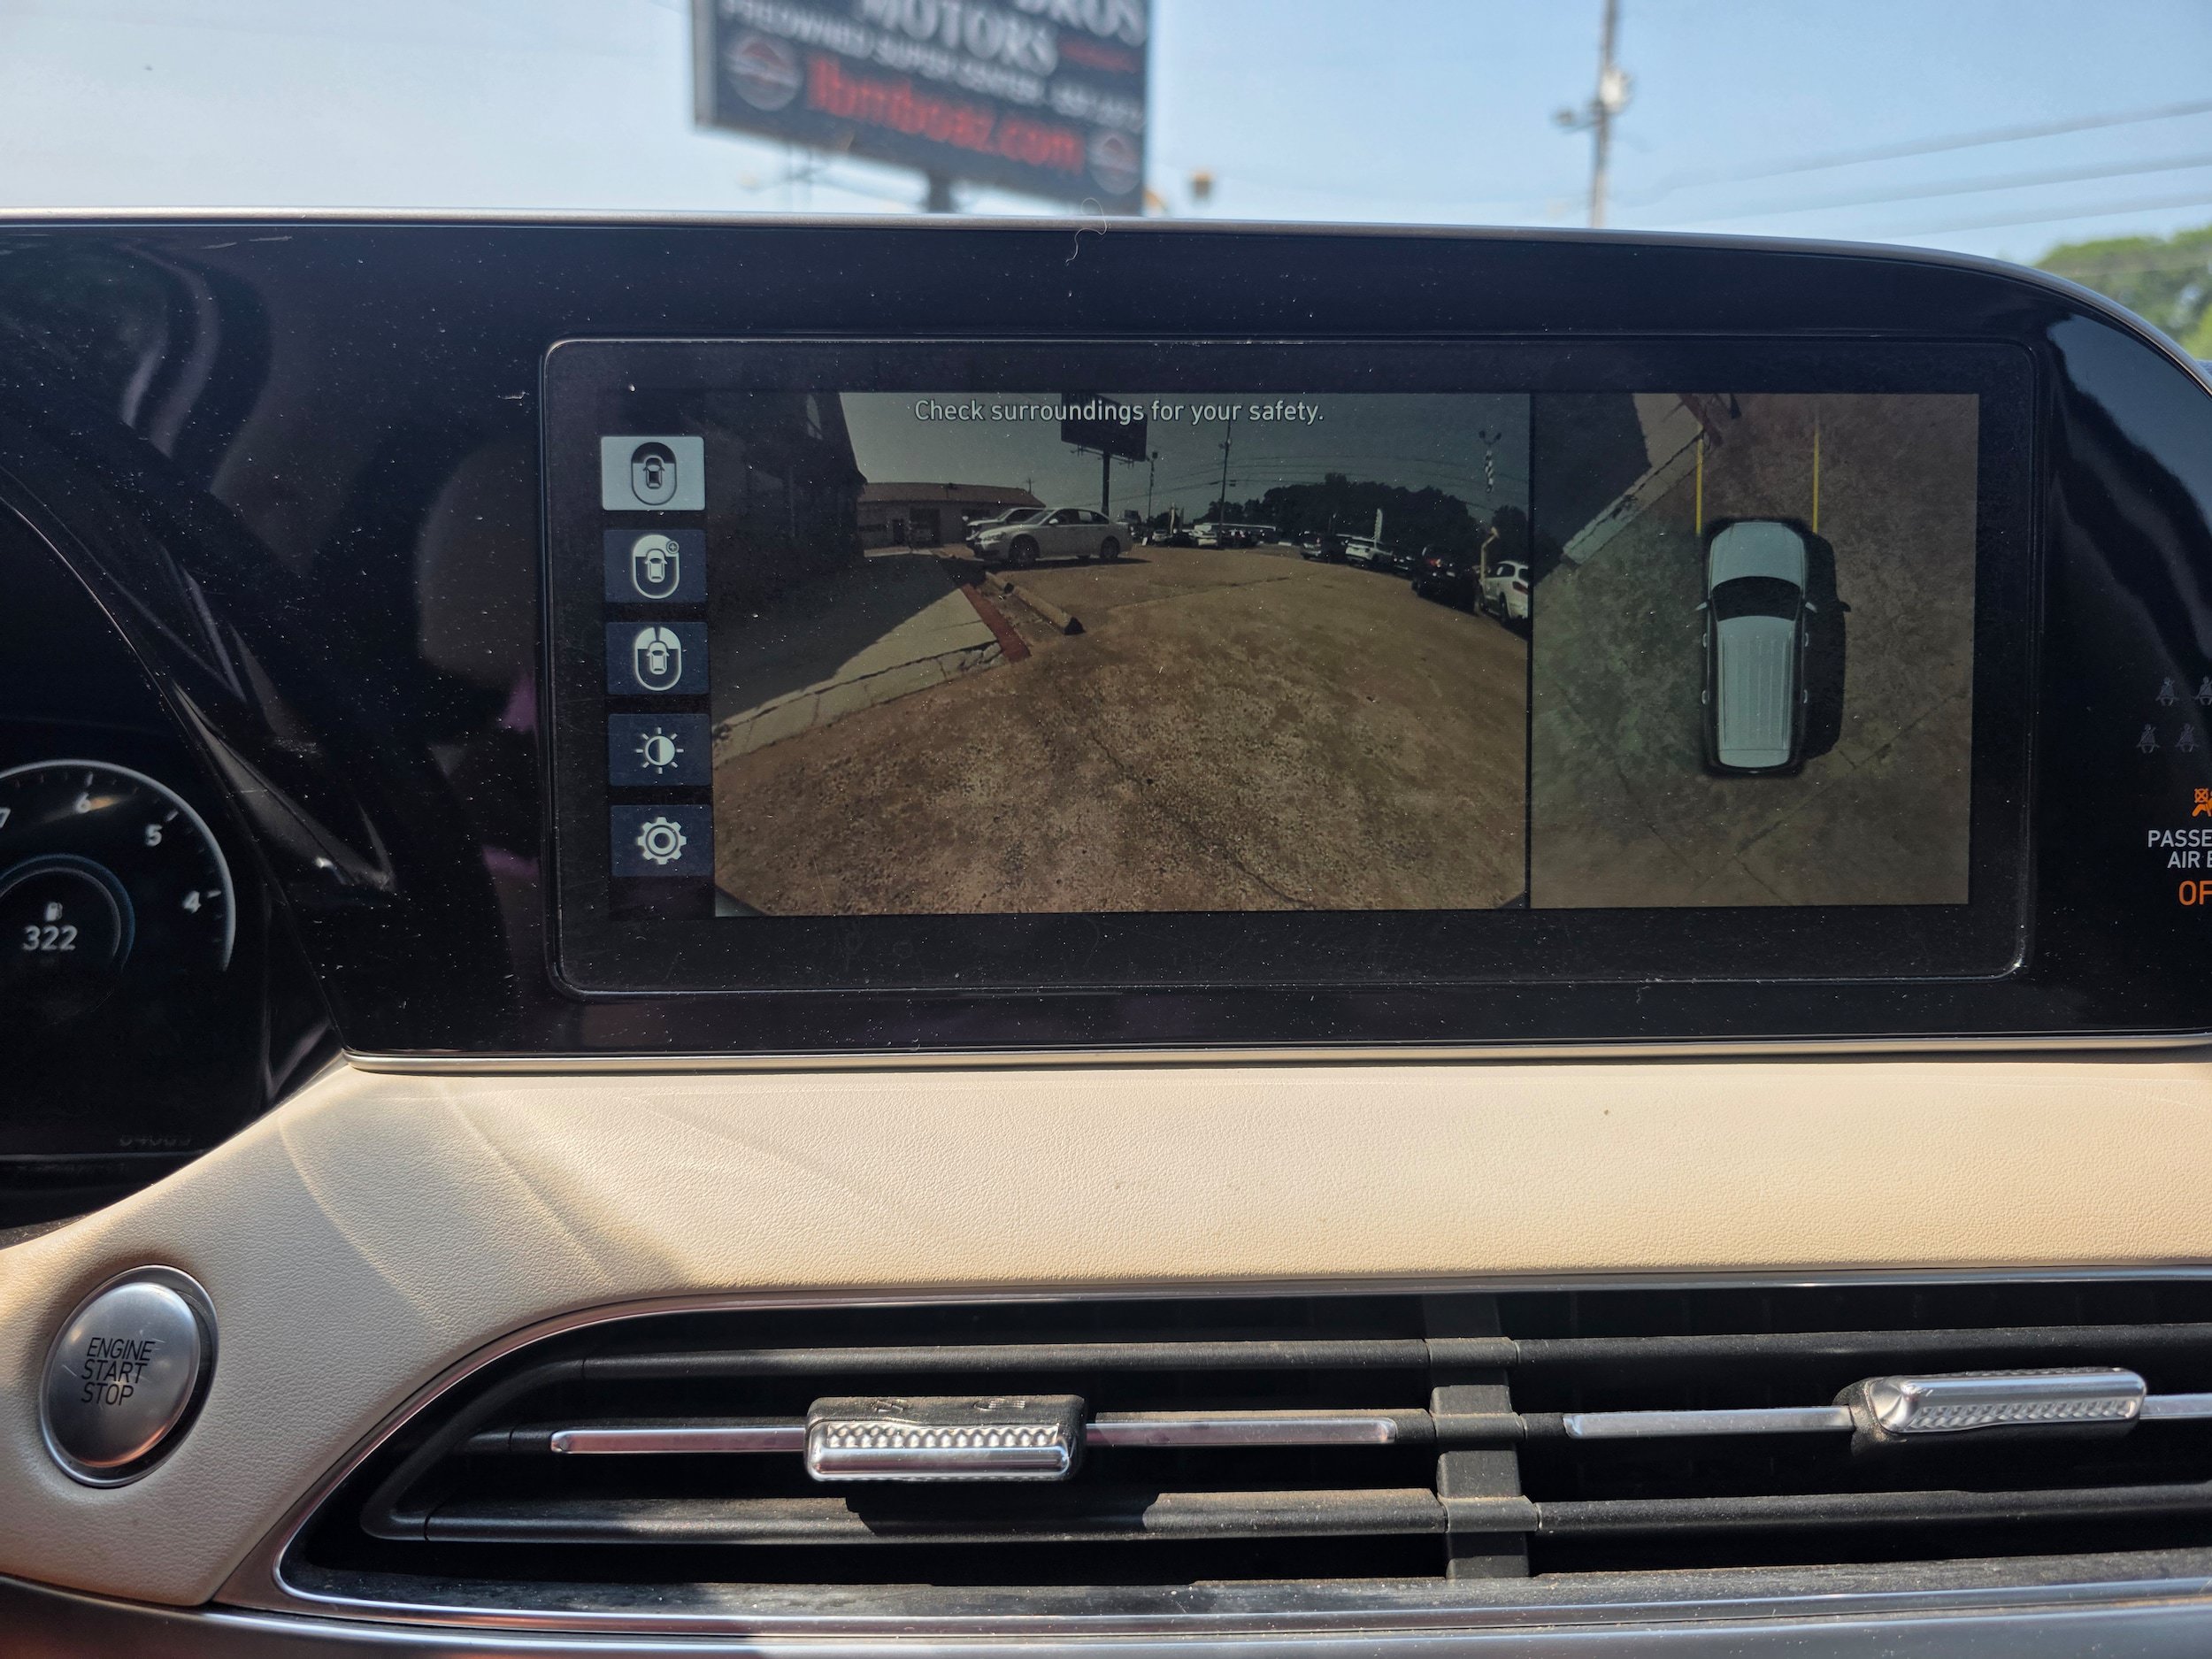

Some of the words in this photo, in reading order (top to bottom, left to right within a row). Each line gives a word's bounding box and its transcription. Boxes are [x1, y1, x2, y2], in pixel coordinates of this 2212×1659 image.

[1015, 0, 1148, 47] ROS
[914, 400, 985, 421] Check
[991, 400, 1145, 426] surroundings
[1151, 399, 1185, 421] for
[1191, 403, 1242, 426] your
[1249, 399, 1325, 426] safety.
[75, 793, 92, 814] 6
[145, 824, 163, 847] 5
[2147, 829, 2212, 848] PASSE
[2168, 850, 2200, 869] AIR
[182, 890, 201, 913] 4
[2178, 880, 2212, 906] OF
[22, 925, 79, 951] 322
[86, 1337, 156, 1362] ENGINE
[81, 1359, 148, 1384] START
[81, 1382, 134, 1406] STOP
